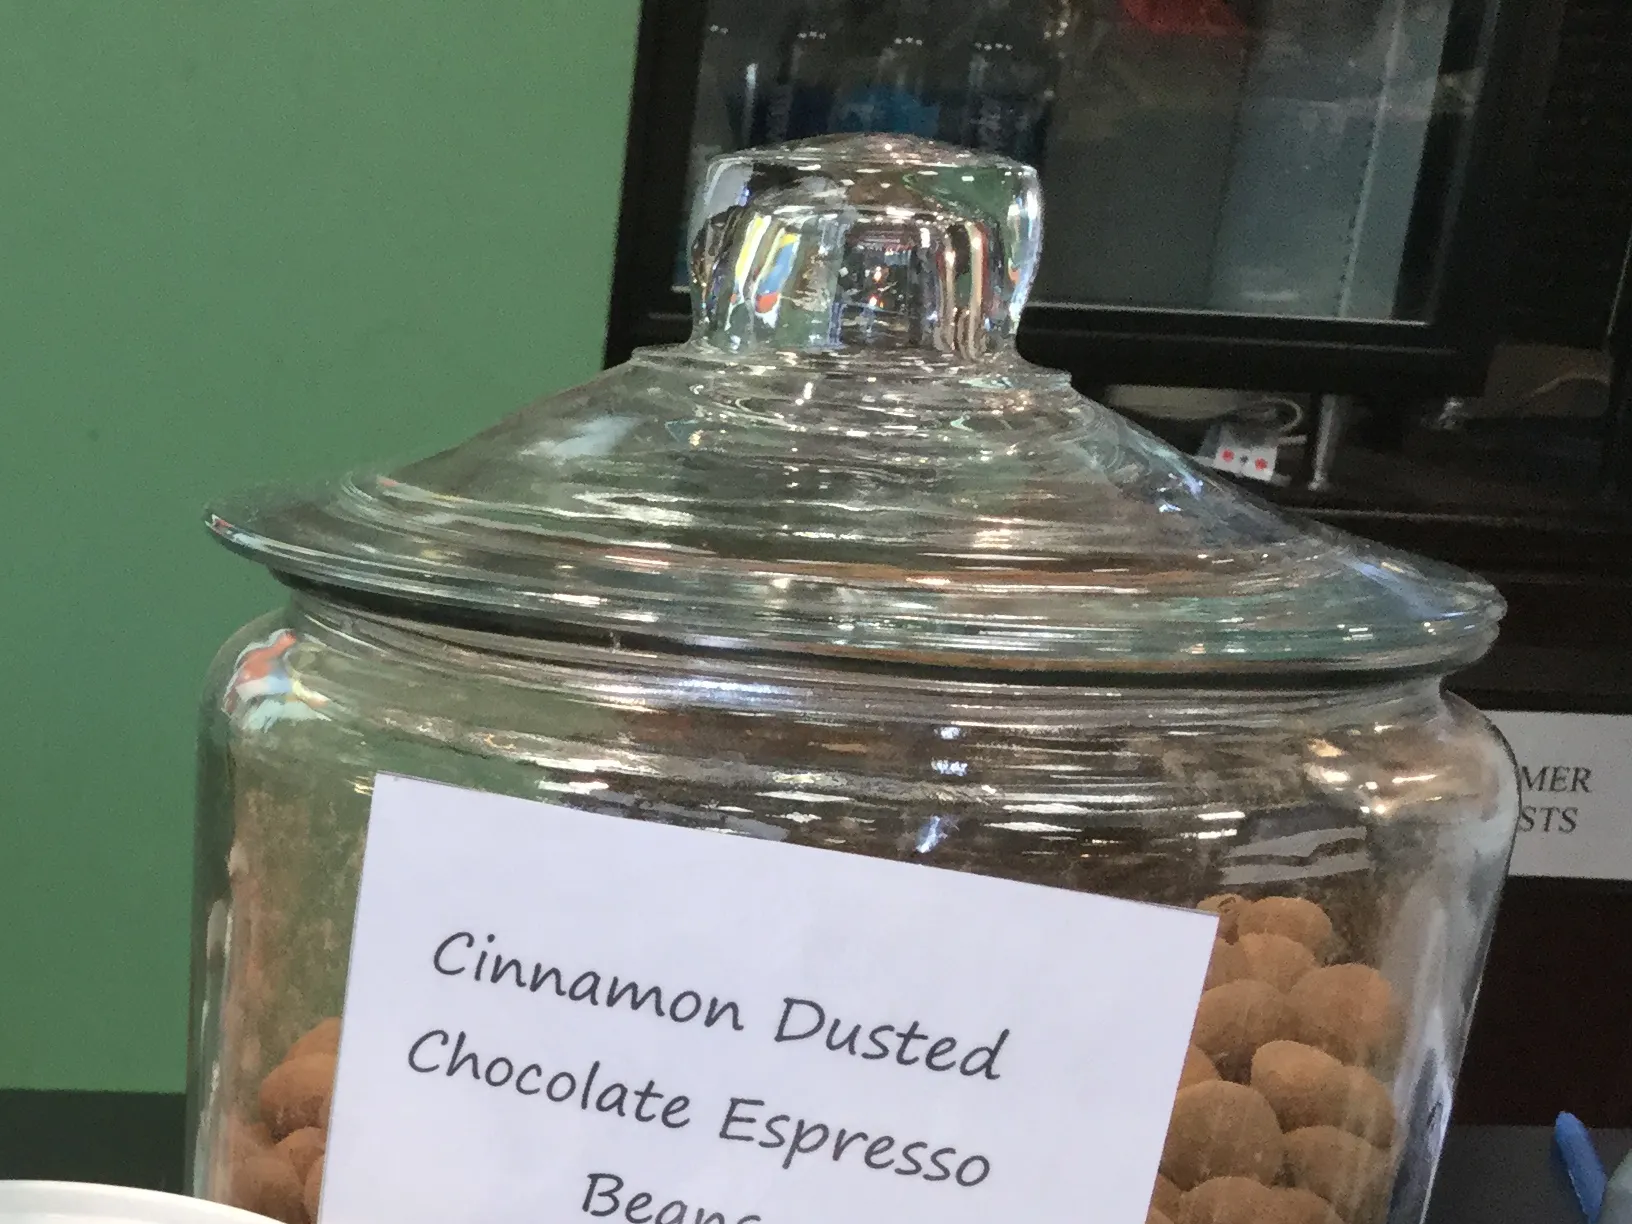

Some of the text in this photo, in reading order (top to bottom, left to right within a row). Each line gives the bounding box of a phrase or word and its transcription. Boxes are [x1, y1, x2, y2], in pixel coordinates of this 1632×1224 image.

[431, 931, 1011, 1081] Cinnamon Dusted
[407, 1028, 992, 1189] Chocolate Espresso
